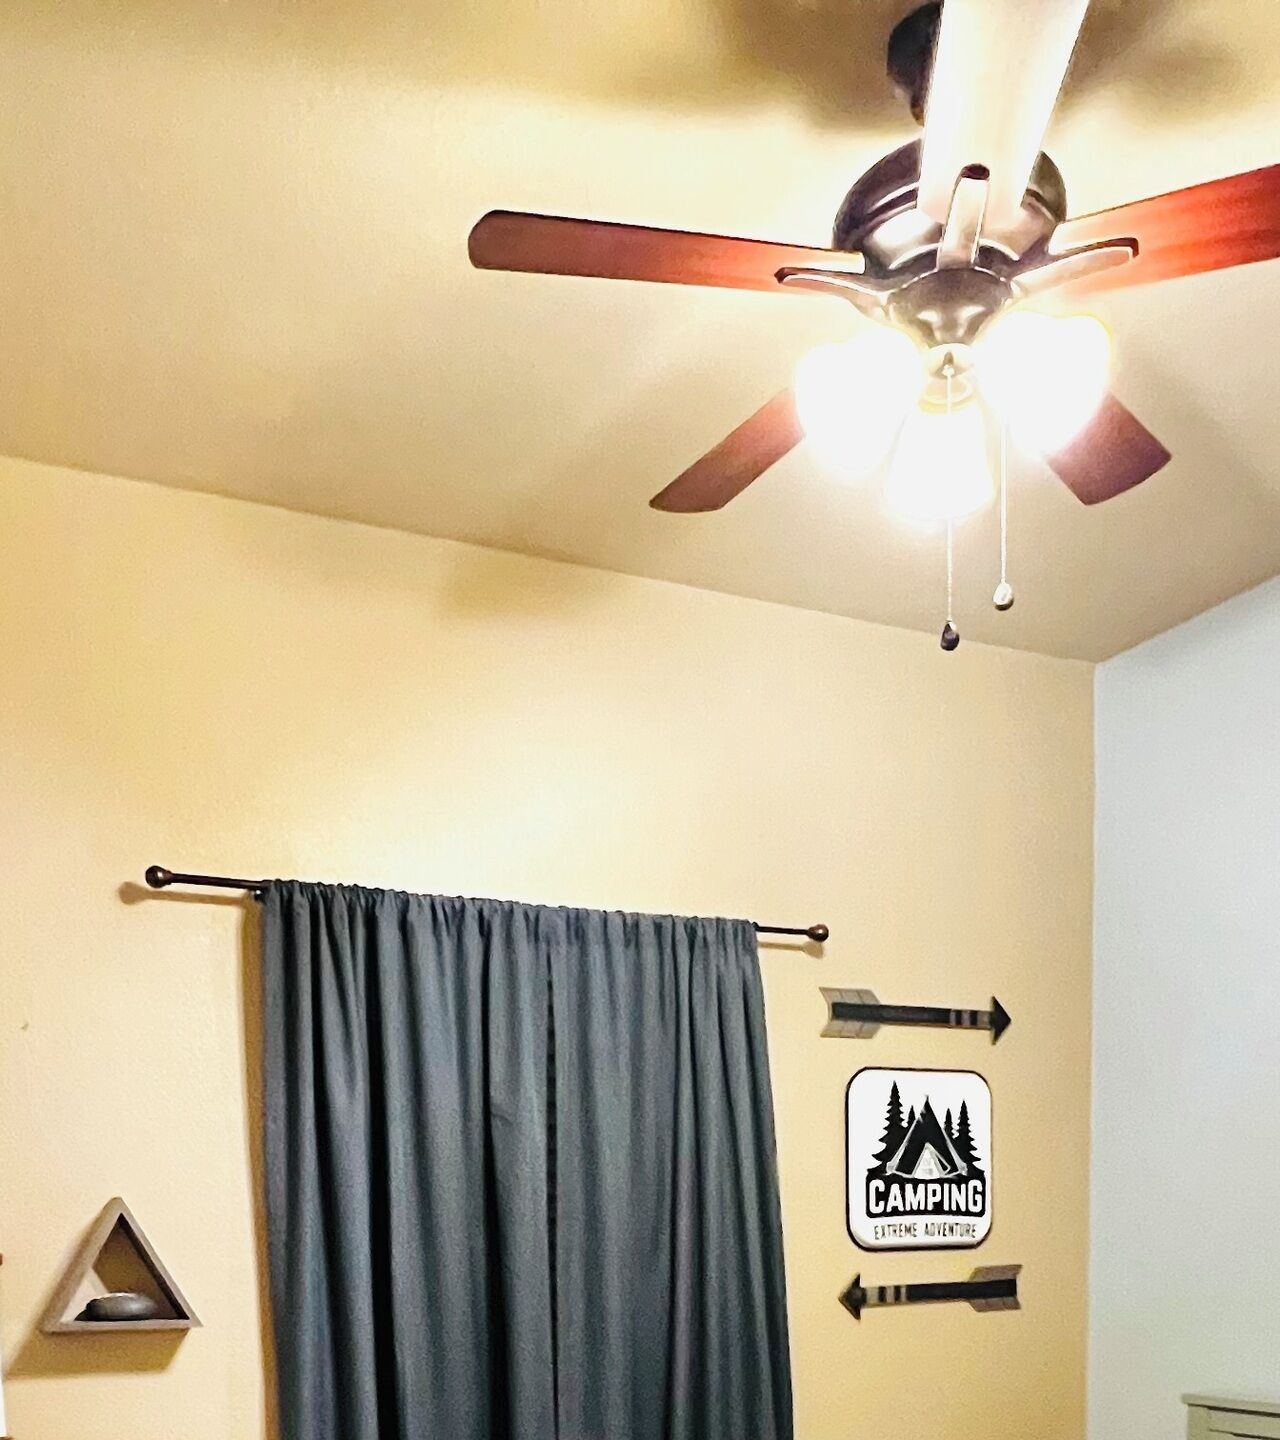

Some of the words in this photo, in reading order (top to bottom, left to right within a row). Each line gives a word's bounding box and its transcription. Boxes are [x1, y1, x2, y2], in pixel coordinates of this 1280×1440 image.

[868, 1178, 983, 1215] CAMPING
[873, 1222, 918, 1240] EXTREME
[924, 1221, 977, 1239] ADVENTURE
